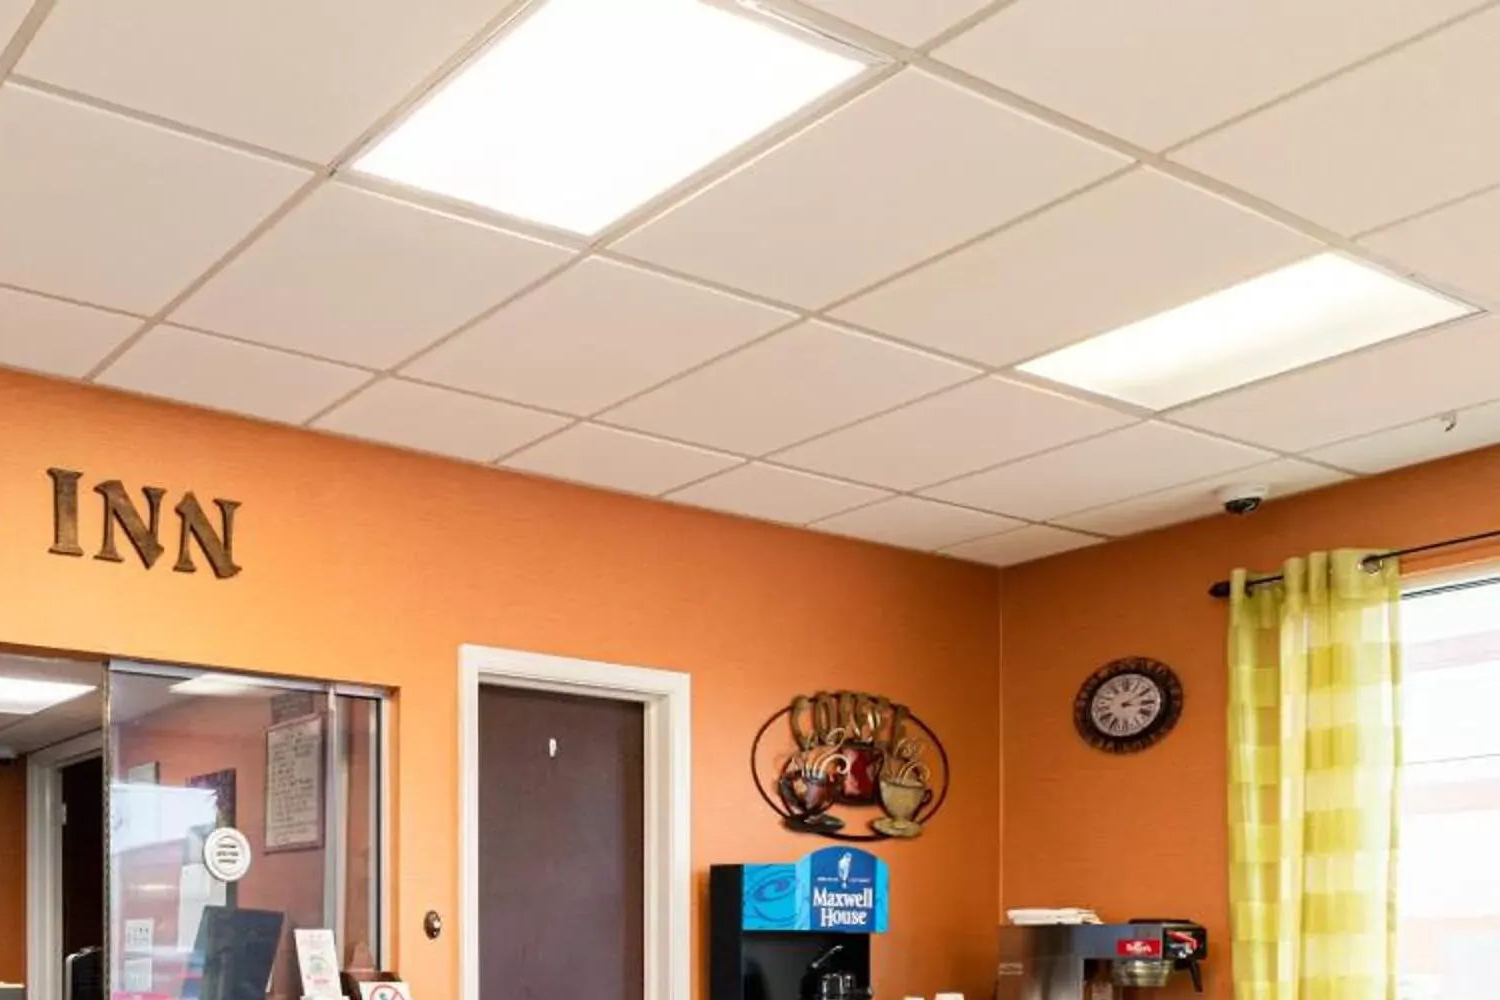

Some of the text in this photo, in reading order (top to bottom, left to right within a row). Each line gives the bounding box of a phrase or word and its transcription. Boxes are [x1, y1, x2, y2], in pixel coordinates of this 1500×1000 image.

[48, 466, 242, 578] INN
[813, 886, 873, 909] Maxwell
[820, 907, 867, 927] House
